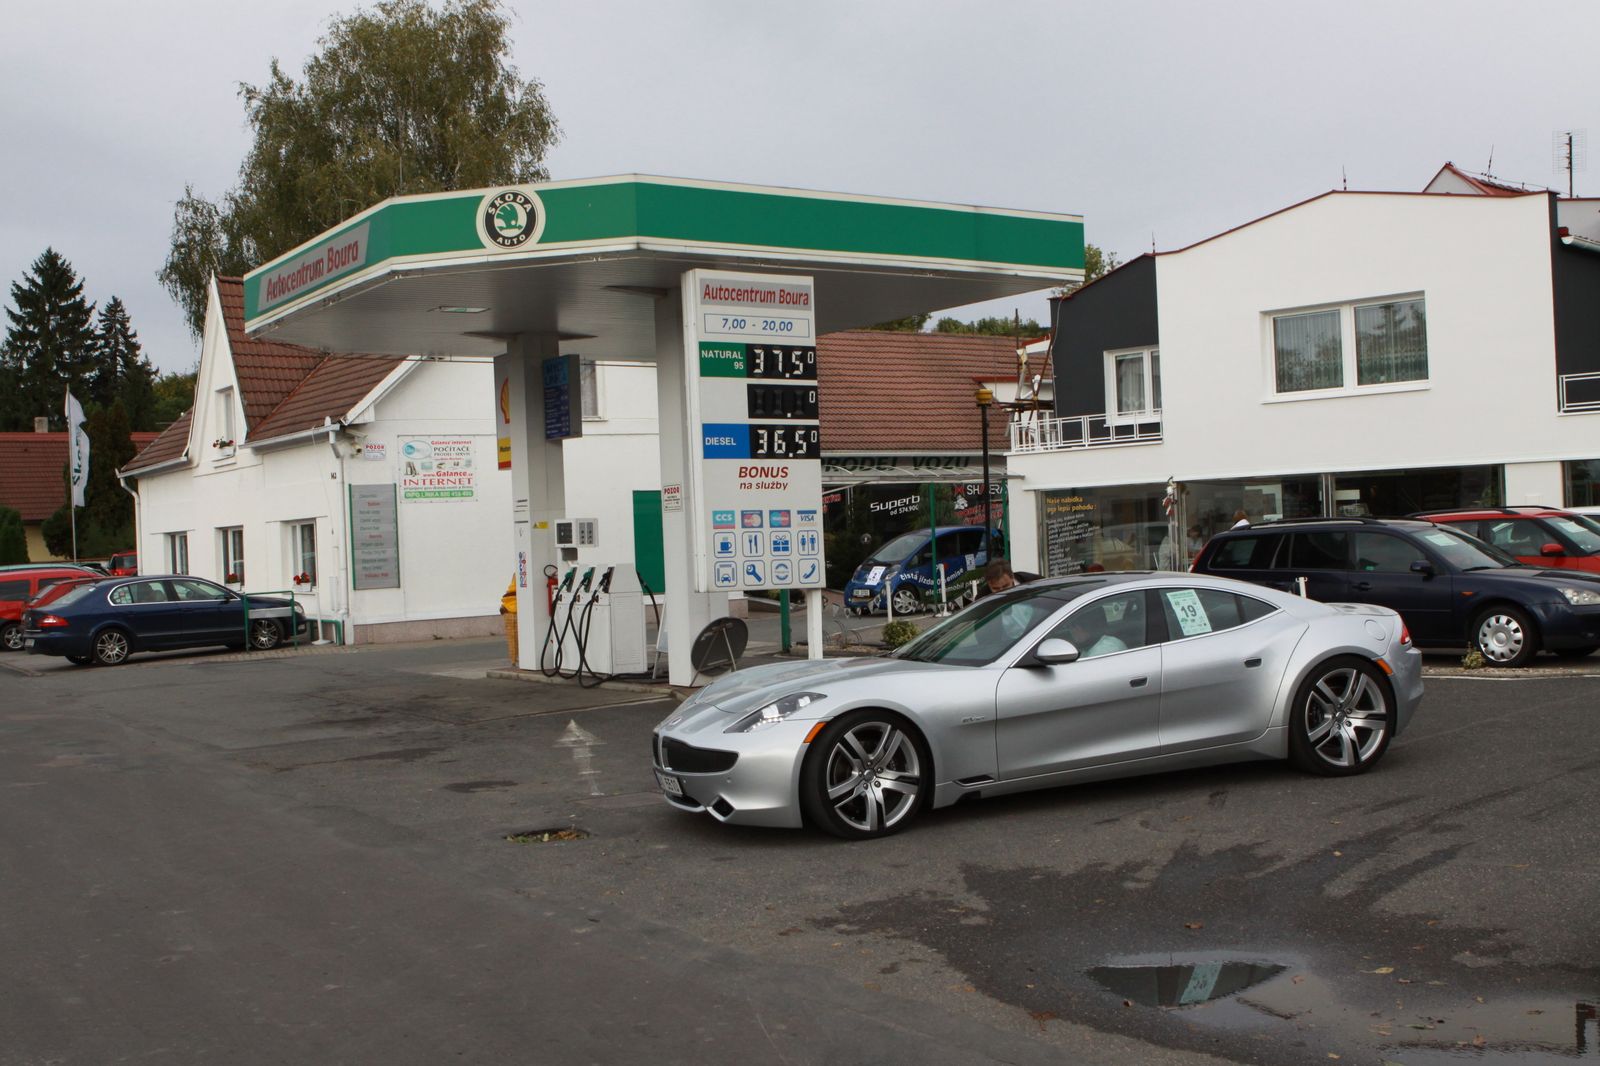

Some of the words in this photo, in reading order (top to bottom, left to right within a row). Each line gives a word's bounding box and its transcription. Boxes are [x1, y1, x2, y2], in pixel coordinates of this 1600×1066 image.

[496, 234, 526, 245] AUTO
[266, 257, 324, 303] Autocentrum
[326, 240, 359, 274] Boura
[703, 284, 776, 303] Autocentrum
[778, 289, 809, 306] Boura
[721, 318, 747, 331] 7,00
[762, 320, 793, 332] 20,00
[701, 349, 744, 360] NATURAL
[733, 361, 744, 370] 95
[705, 437, 737, 446] DIESEL
[738, 466, 789, 478] BONUS
[403, 478, 473, 486] INTERNET
[755, 481, 788, 491] služby
[869, 494, 921, 513] Superb
[715, 513, 733, 522] CCS
[800, 514, 815, 522] VISA
[925, 581, 964, 596] eletrmobil
[1181, 604, 1197, 618] 19
